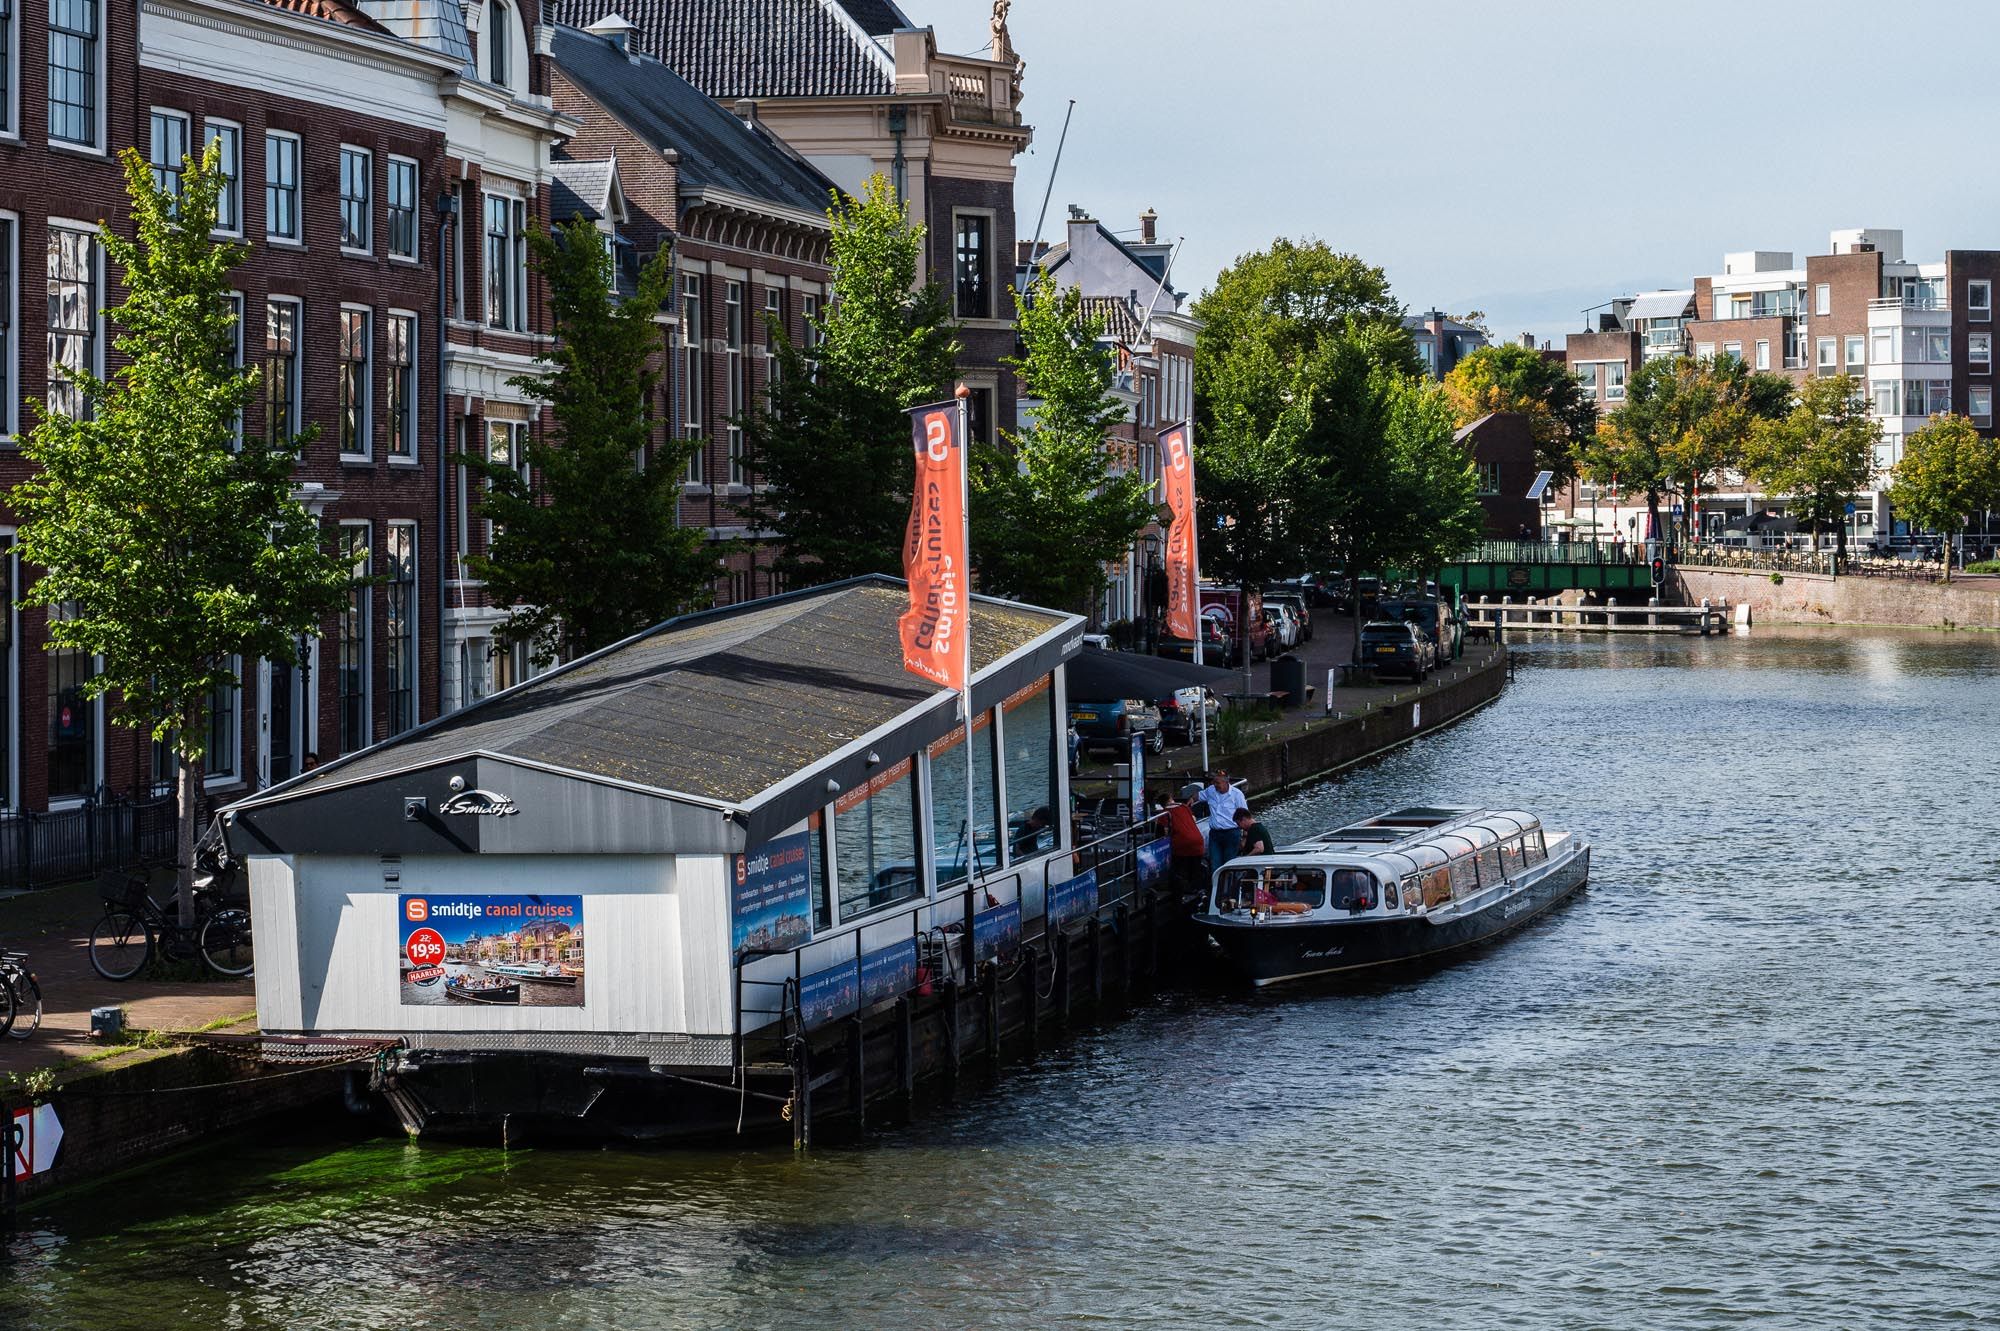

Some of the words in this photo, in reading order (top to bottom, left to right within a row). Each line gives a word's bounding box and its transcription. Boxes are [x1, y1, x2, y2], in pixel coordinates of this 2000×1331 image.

[449, 801, 517, 817] Smidtje
[747, 853, 769, 876] smidtje
[409, 901, 425, 918] S
[431, 902, 482, 920] smidtje
[485, 903, 521, 917] canal
[525, 903, 573, 917] cruises
[411, 943, 441, 960] 19,95
[410, 968, 444, 981] HAARLEM
